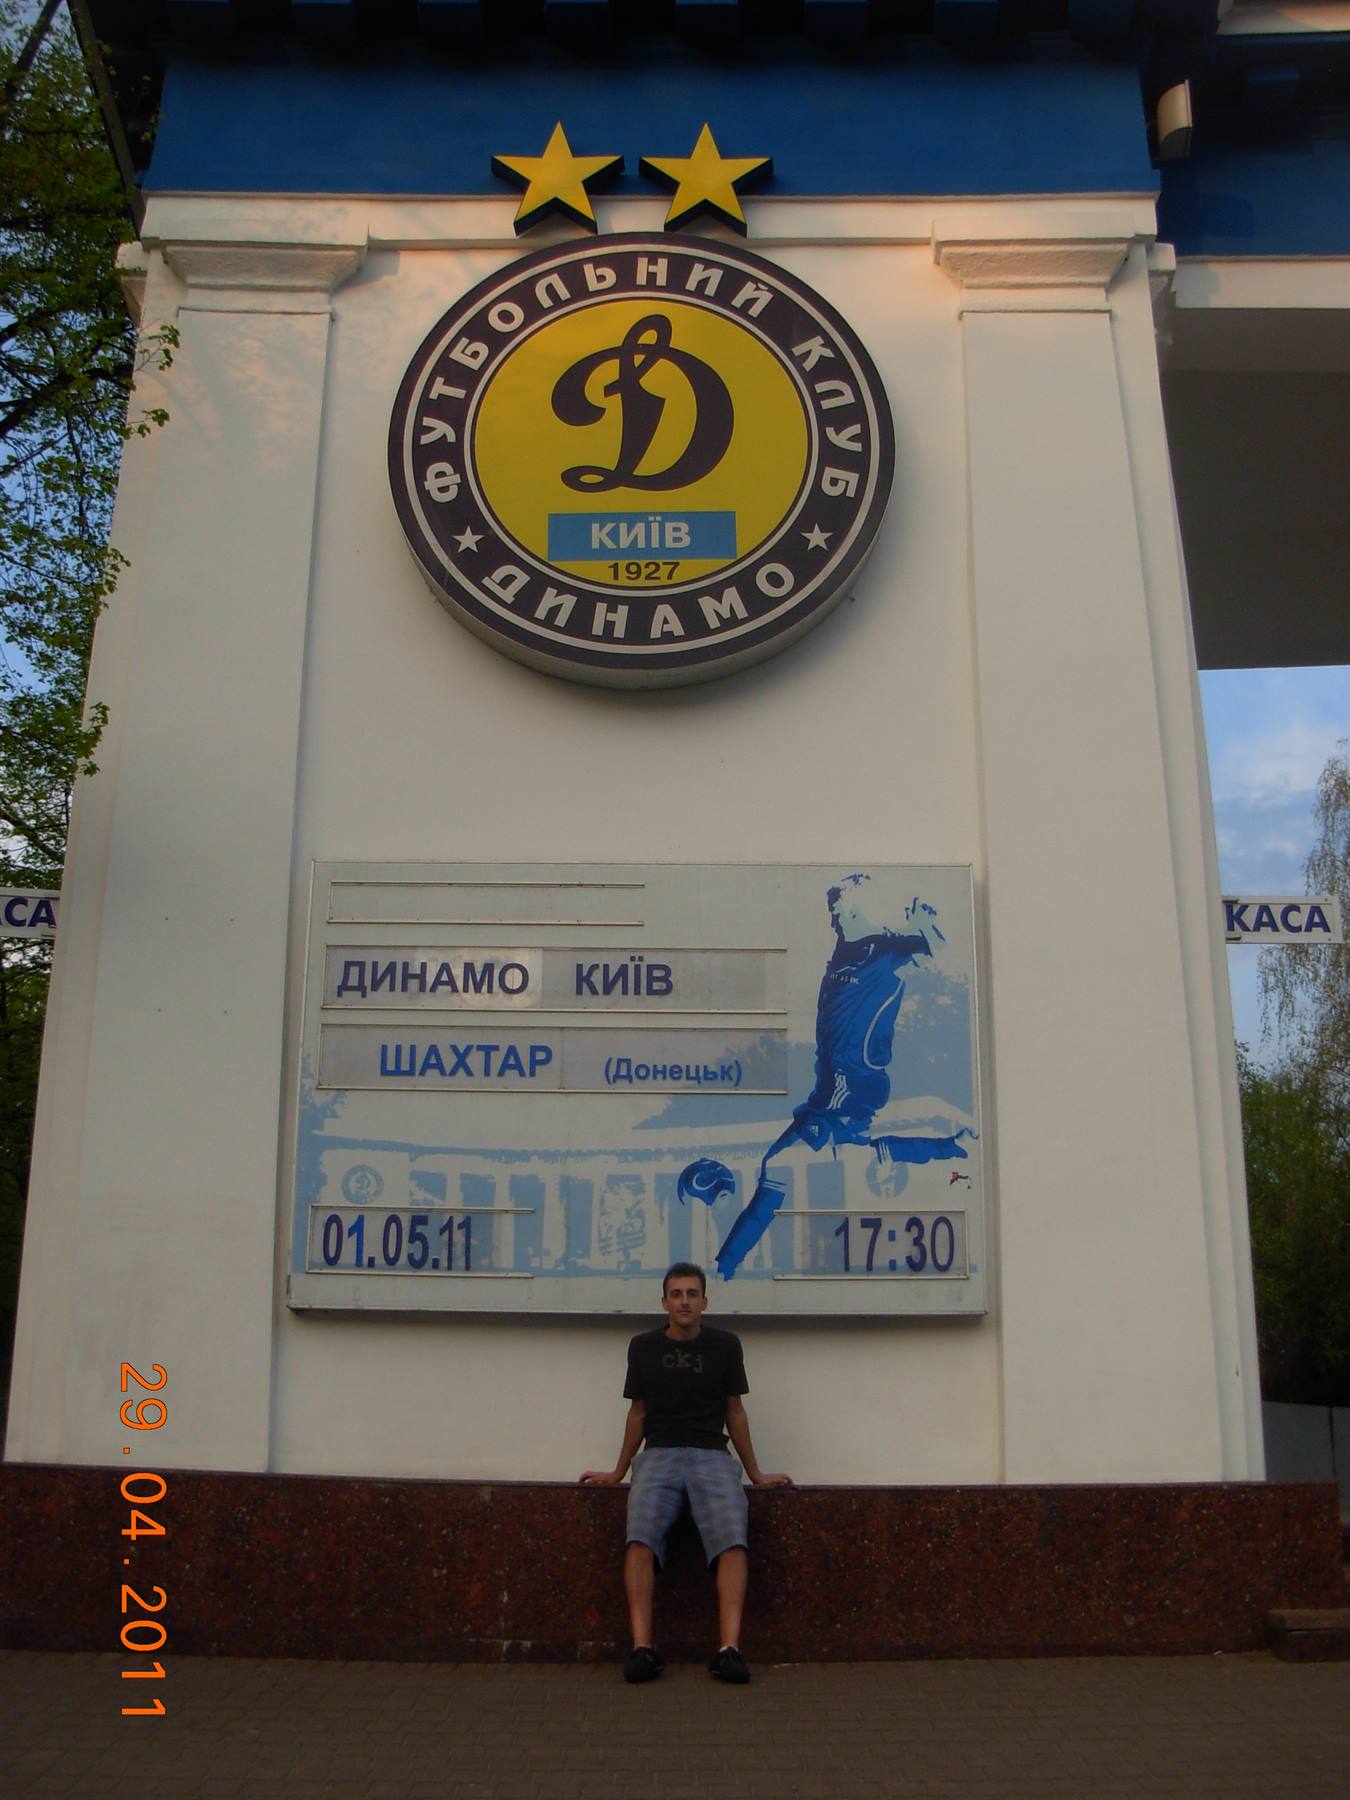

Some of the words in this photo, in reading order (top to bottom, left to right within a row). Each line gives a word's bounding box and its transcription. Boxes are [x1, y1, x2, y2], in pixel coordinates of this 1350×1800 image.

[419, 256, 775, 503] ФУТБОЛЬНИЙ
[790, 335, 864, 499] КЛУБ
[590, 516, 692, 551] КИЇВ
[607, 561, 681, 582] 1927
[481, 562, 796, 639] ДИНАМО
[0, 896, 57, 929] СА
[1225, 903, 1332, 934] КАСА
[336, 960, 530, 998] ДИНАМО
[575, 956, 674, 996] КИЇВ
[380, 1044, 553, 1078] ШАХТАР
[604, 1057, 742, 1086] (Донецьк)
[323, 1213, 472, 1272] 01.05.11
[834, 1215, 955, 1273] 17:30
